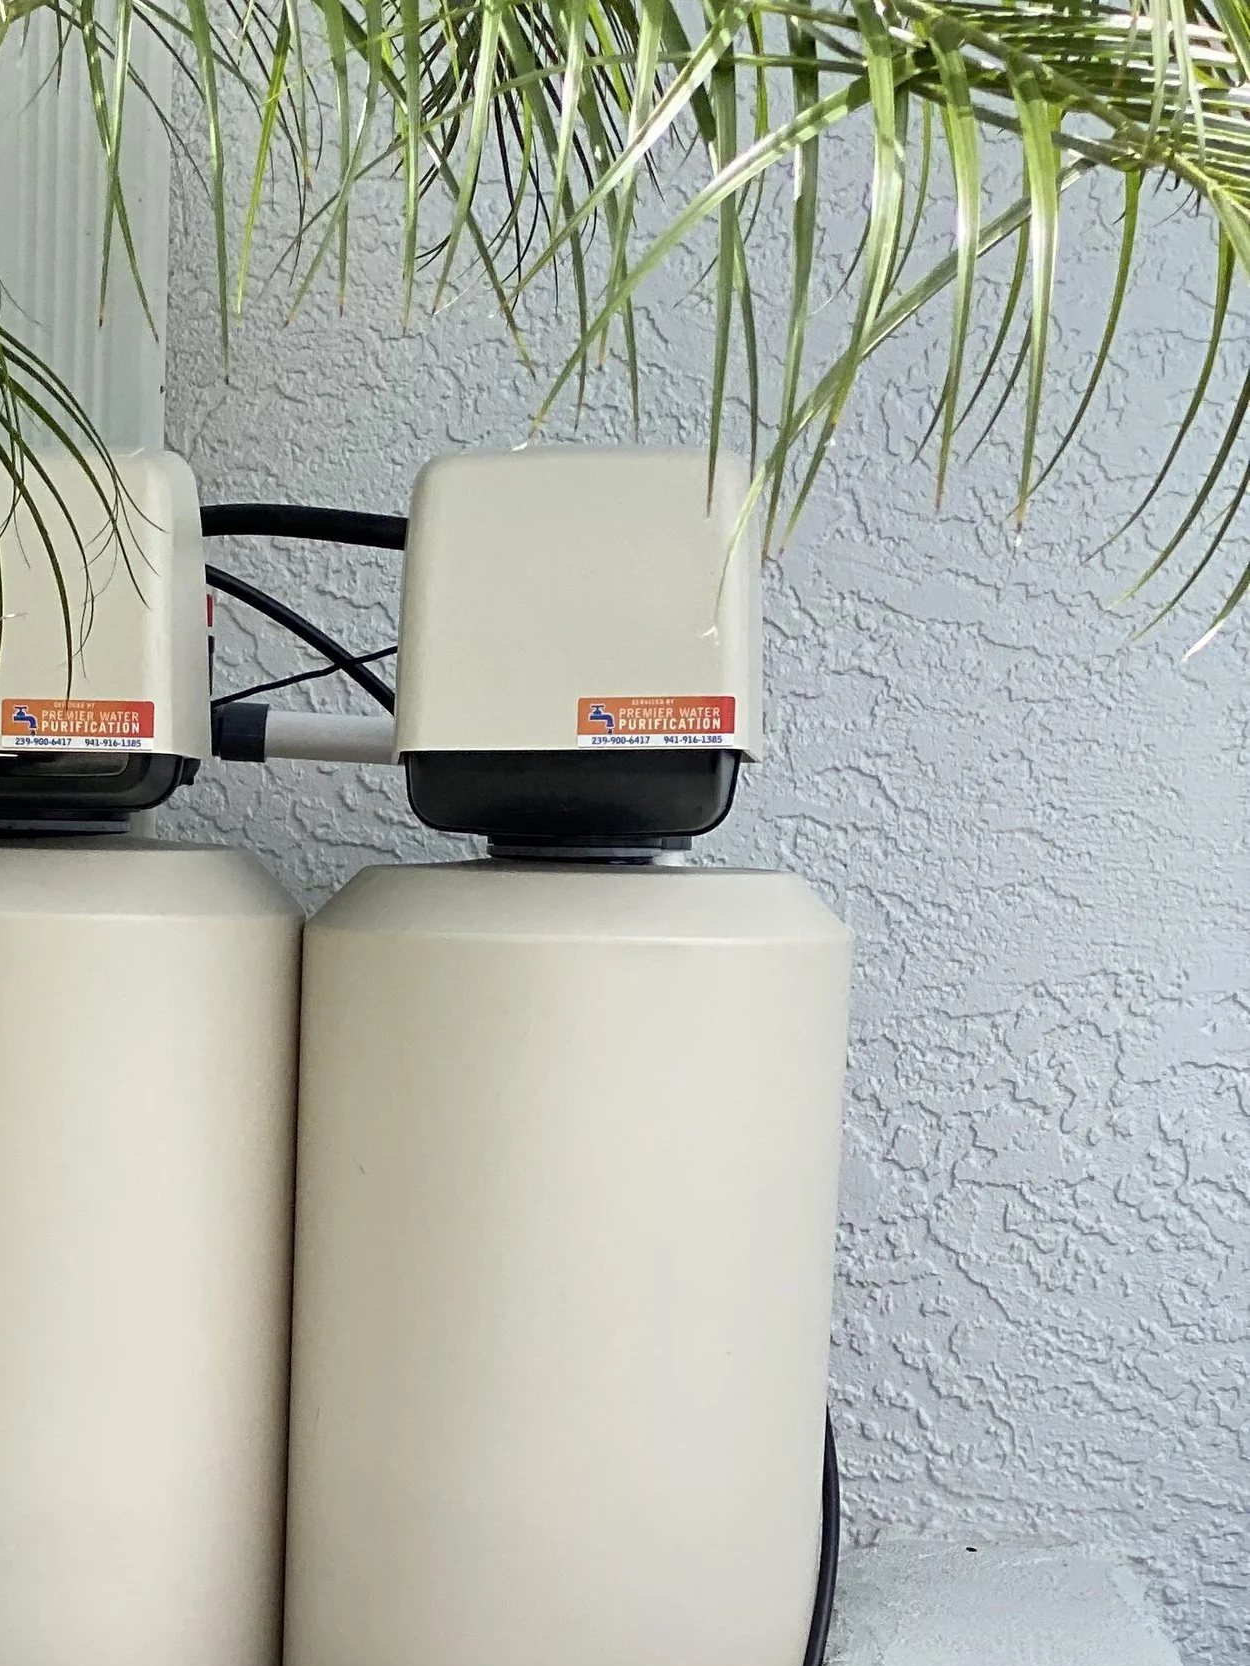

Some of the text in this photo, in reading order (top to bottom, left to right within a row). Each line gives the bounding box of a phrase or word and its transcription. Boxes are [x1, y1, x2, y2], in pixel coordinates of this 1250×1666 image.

[41, 709, 139, 722] PREMIER WATER
[618, 707, 720, 718] PREMIER WATER
[41, 721, 140, 734] PURIFICATION
[618, 718, 721, 731] PURIFICATION
[15, 738, 142, 747] 239-900-6417 941-916-1385
[591, 735, 723, 745] 239-900-6417 941-916-1385
